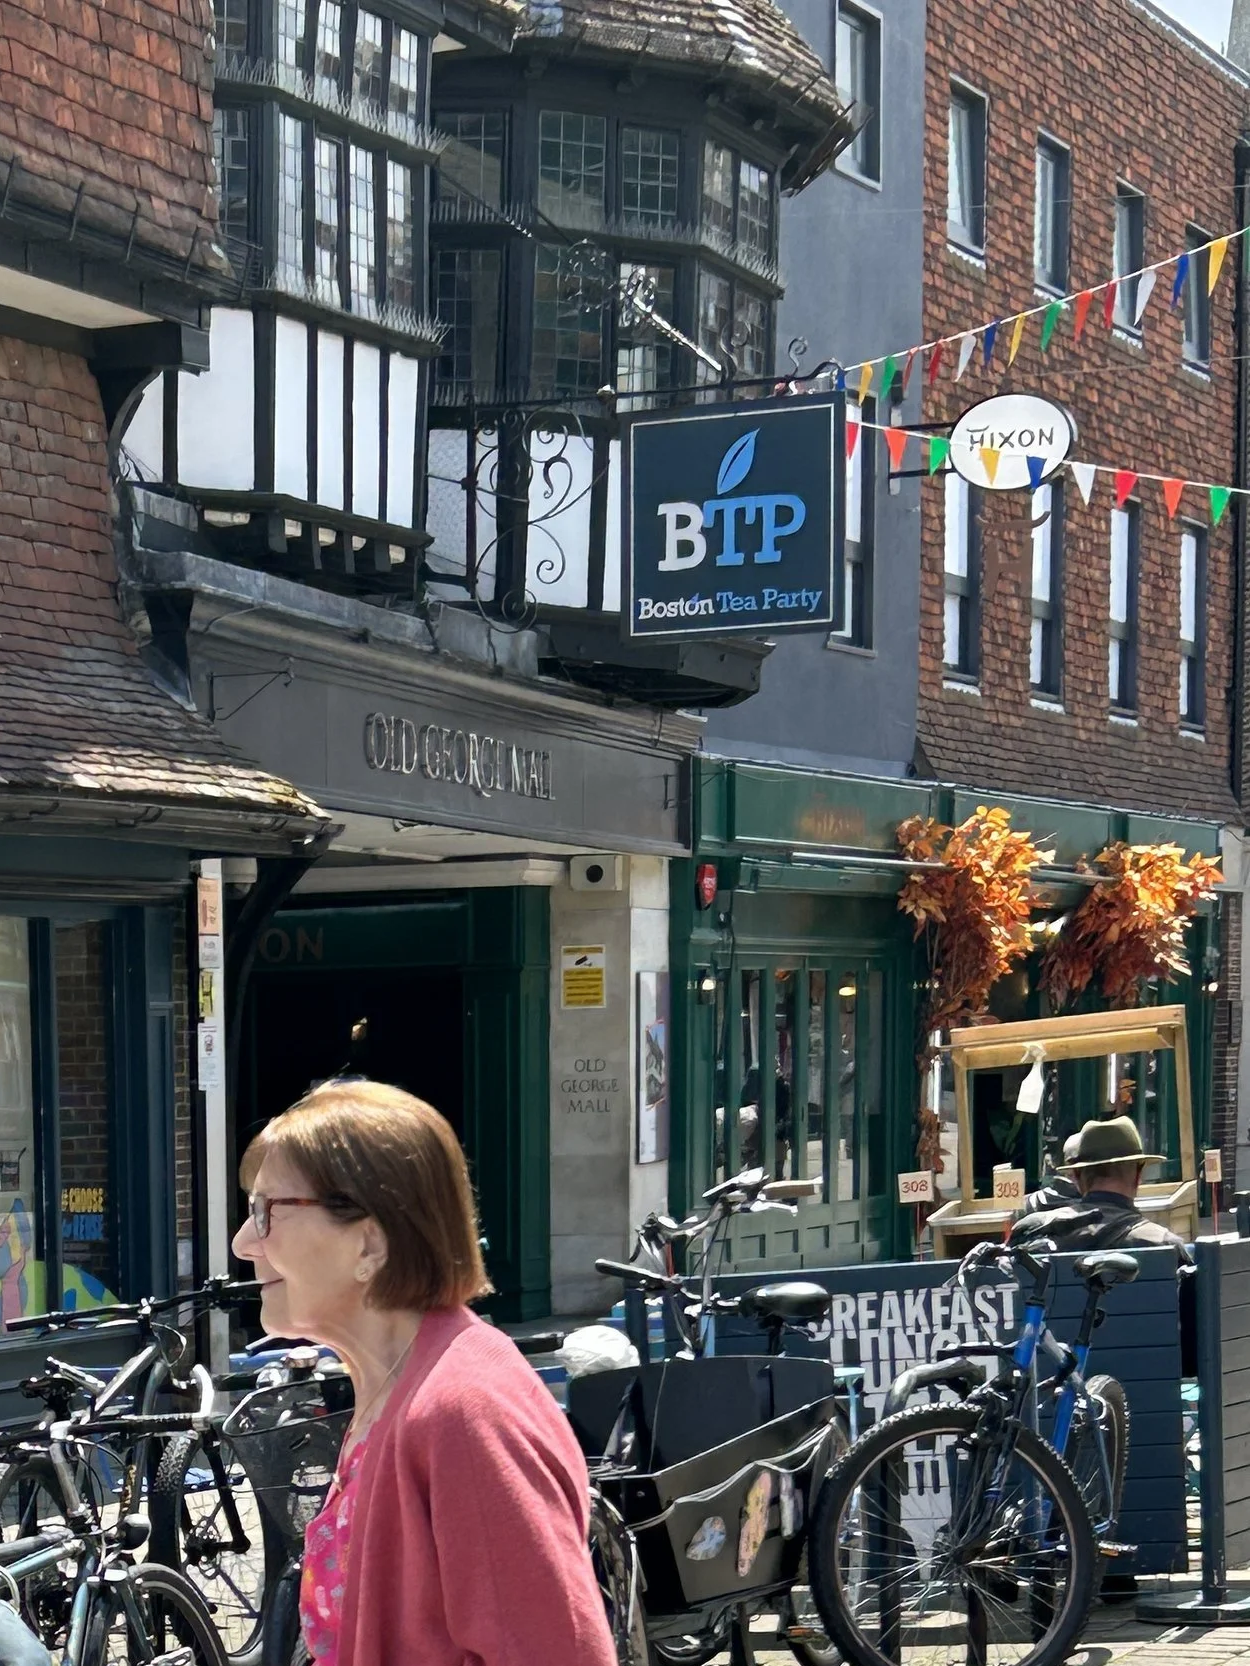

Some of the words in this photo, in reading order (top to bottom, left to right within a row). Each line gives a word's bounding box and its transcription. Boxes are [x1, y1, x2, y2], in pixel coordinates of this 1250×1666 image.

[966, 425, 1054, 451] HIXON
[657, 494, 806, 572] BTP
[638, 593, 715, 620] Boston
[716, 591, 758, 613] Tea
[762, 588, 823, 613] Party
[370, 712, 417, 774] OLD
[424, 724, 507, 798] GEORGE
[511, 743, 556, 800] MALL
[574, 1058, 606, 1072] OLD
[561, 1078, 620, 1093] GEORGE
[566, 1099, 611, 1113] MALL
